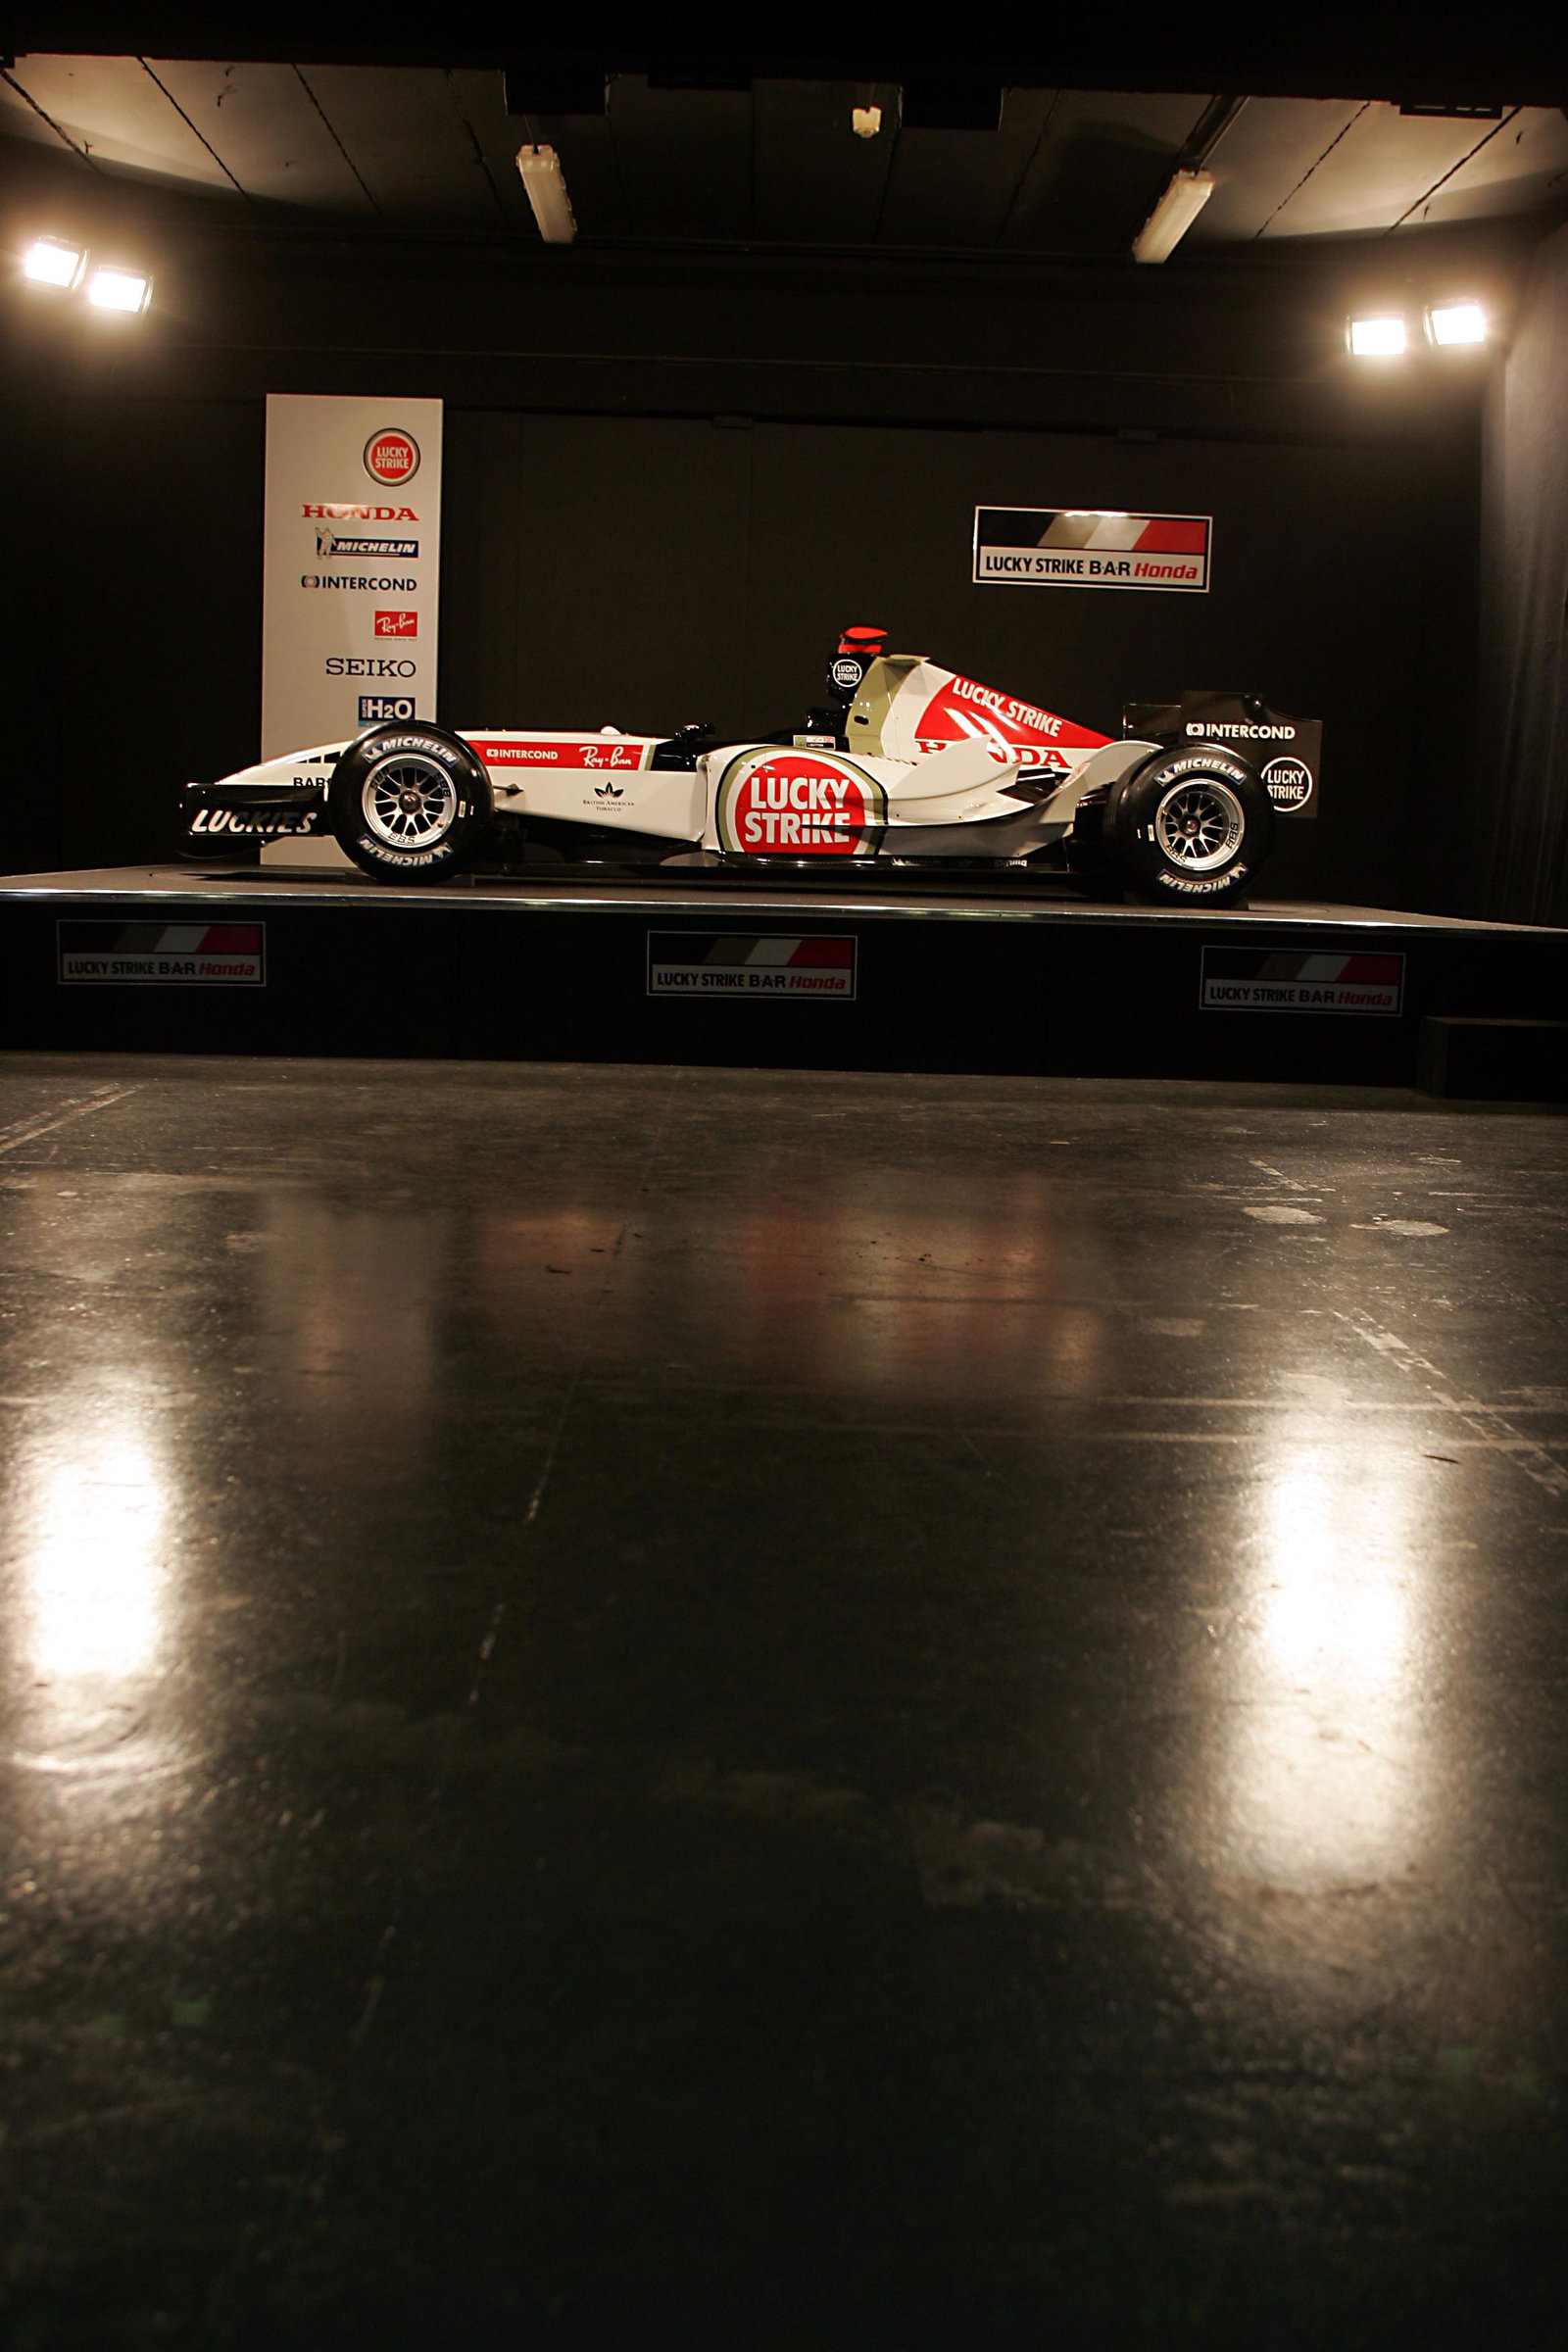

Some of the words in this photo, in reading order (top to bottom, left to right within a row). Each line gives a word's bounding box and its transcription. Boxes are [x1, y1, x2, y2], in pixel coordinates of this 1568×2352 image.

[376, 446, 409, 458] LUCKY
[375, 458, 410, 469] STRIKE
[302, 504, 419, 521] HONDA
[336, 540, 416, 554] MICHELIN
[985, 556, 1033, 572] LUCKY
[1035, 558, 1084, 574] STRIKE
[1133, 563, 1199, 579] Honda
[322, 576, 417, 591] INTERCOND
[376, 612, 415, 634] Ray-Ban
[325, 658, 416, 678] SEIKO
[837, 664, 858, 673] LUCKY
[837, 672, 858, 681] STRIKE
[367, 699, 413, 719] H2O
[952, 677, 1005, 713] LUCKY
[1005, 701, 1063, 738] STRIKE
[1205, 723, 1296, 739] INTERCOND
[382, 736, 458, 765] MICHELIN
[499, 748, 559, 760] INTERCOND
[578, 746, 632, 767] Ray-Ban
[1173, 758, 1246, 783] MICHELIN
[1267, 768, 1304, 784] LUCKY
[751, 776, 850, 810] LUCKY
[1266, 784, 1304, 801] STRIKE
[190, 808, 318, 834] LUCKIES
[744, 810, 851, 844] STRIKE
[361, 837, 435, 867] MICHELIN
[1159, 872, 1232, 894] MICHELIN
[68, 960, 110, 975] LUCKY
[112, 961, 155, 975] STRIKE
[199, 962, 256, 977] Honda
[658, 972, 699, 987] LUCKY
[701, 973, 745, 988] STRIKE
[789, 975, 846, 990] Honda
[1209, 986, 1251, 1001] LUCKY
[1252, 988, 1295, 1003] STRIKE
[1338, 992, 1394, 1006] Honda
